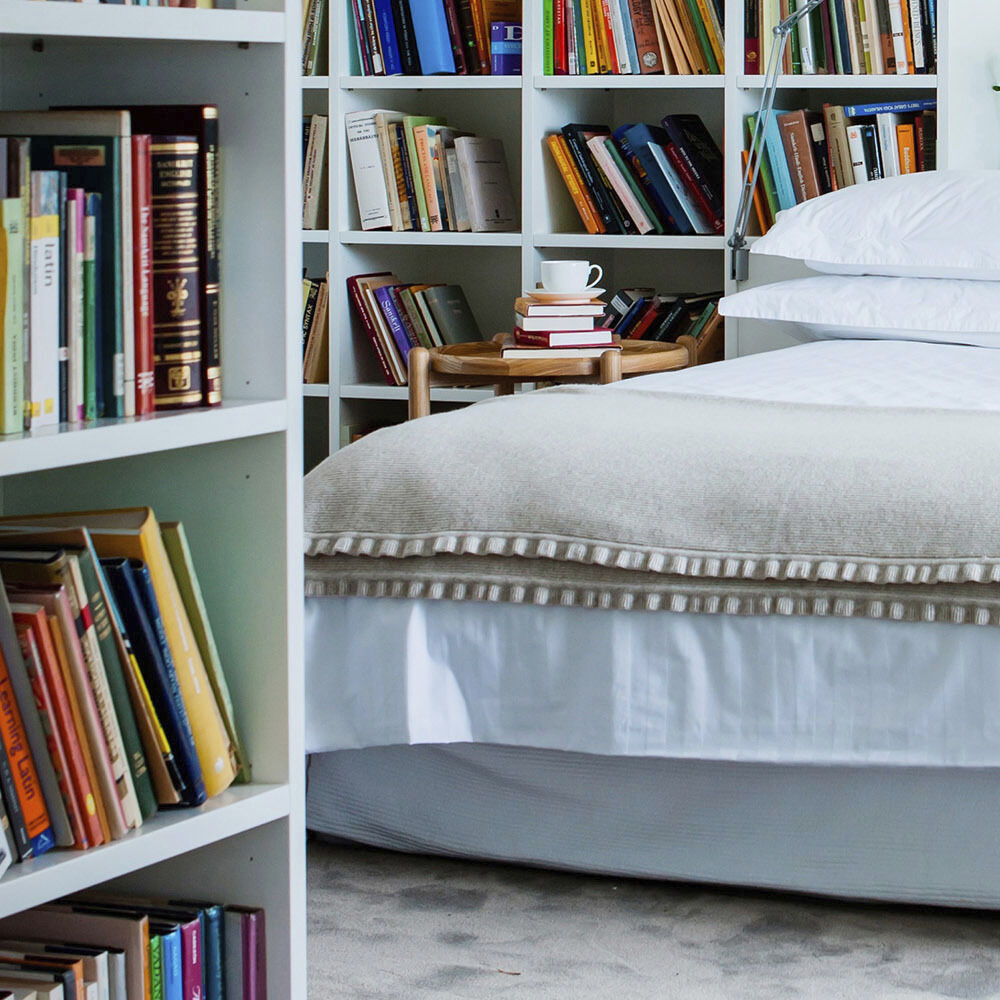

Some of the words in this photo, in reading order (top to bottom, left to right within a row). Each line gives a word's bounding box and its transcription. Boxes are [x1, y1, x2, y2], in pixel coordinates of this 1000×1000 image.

[44, 241, 56, 288] latin
[302, 303, 314, 329] SYNTAX
[378, 298, 405, 332] Sanskrit
[17, 754, 36, 801] Latin
